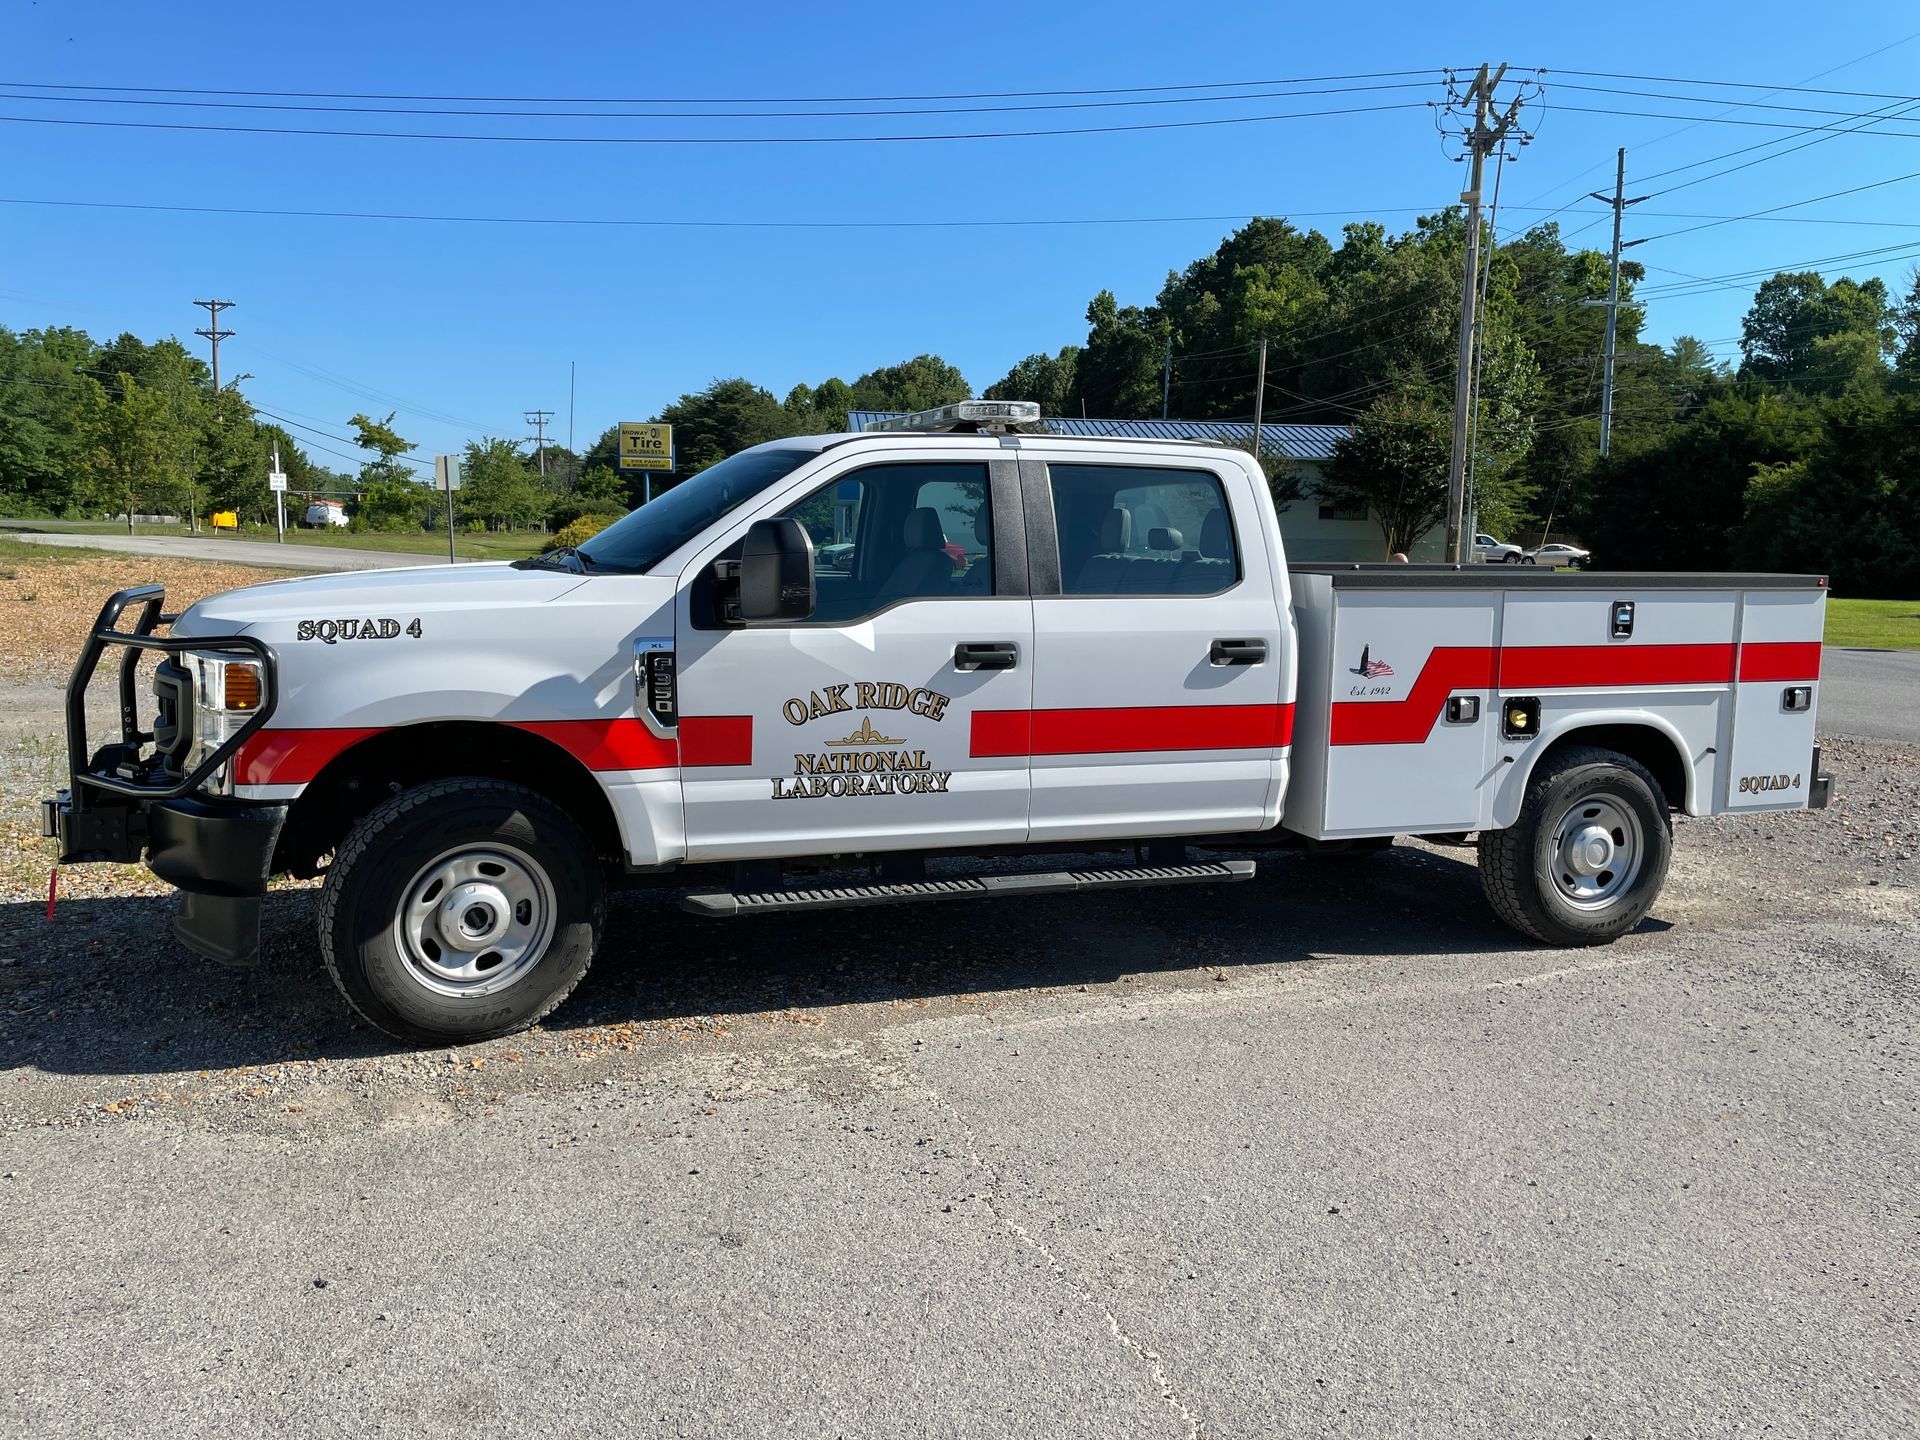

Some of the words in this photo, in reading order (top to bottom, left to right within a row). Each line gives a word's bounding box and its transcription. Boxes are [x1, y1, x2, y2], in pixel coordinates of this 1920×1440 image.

[630, 437, 662, 448] Tire
[297, 618, 401, 644] SQUAD
[406, 617, 422, 638] 4
[782, 683, 853, 726] OAK
[854, 681, 951, 722] RIDGE
[1350, 686, 1366, 696] Est.
[1370, 686, 1391, 696] 1942
[794, 750, 931, 775] NATIONAL
[770, 771, 952, 799] LABORATORY
[1739, 774, 1790, 794] SQUAD
[1792, 773, 1801, 788] 4
